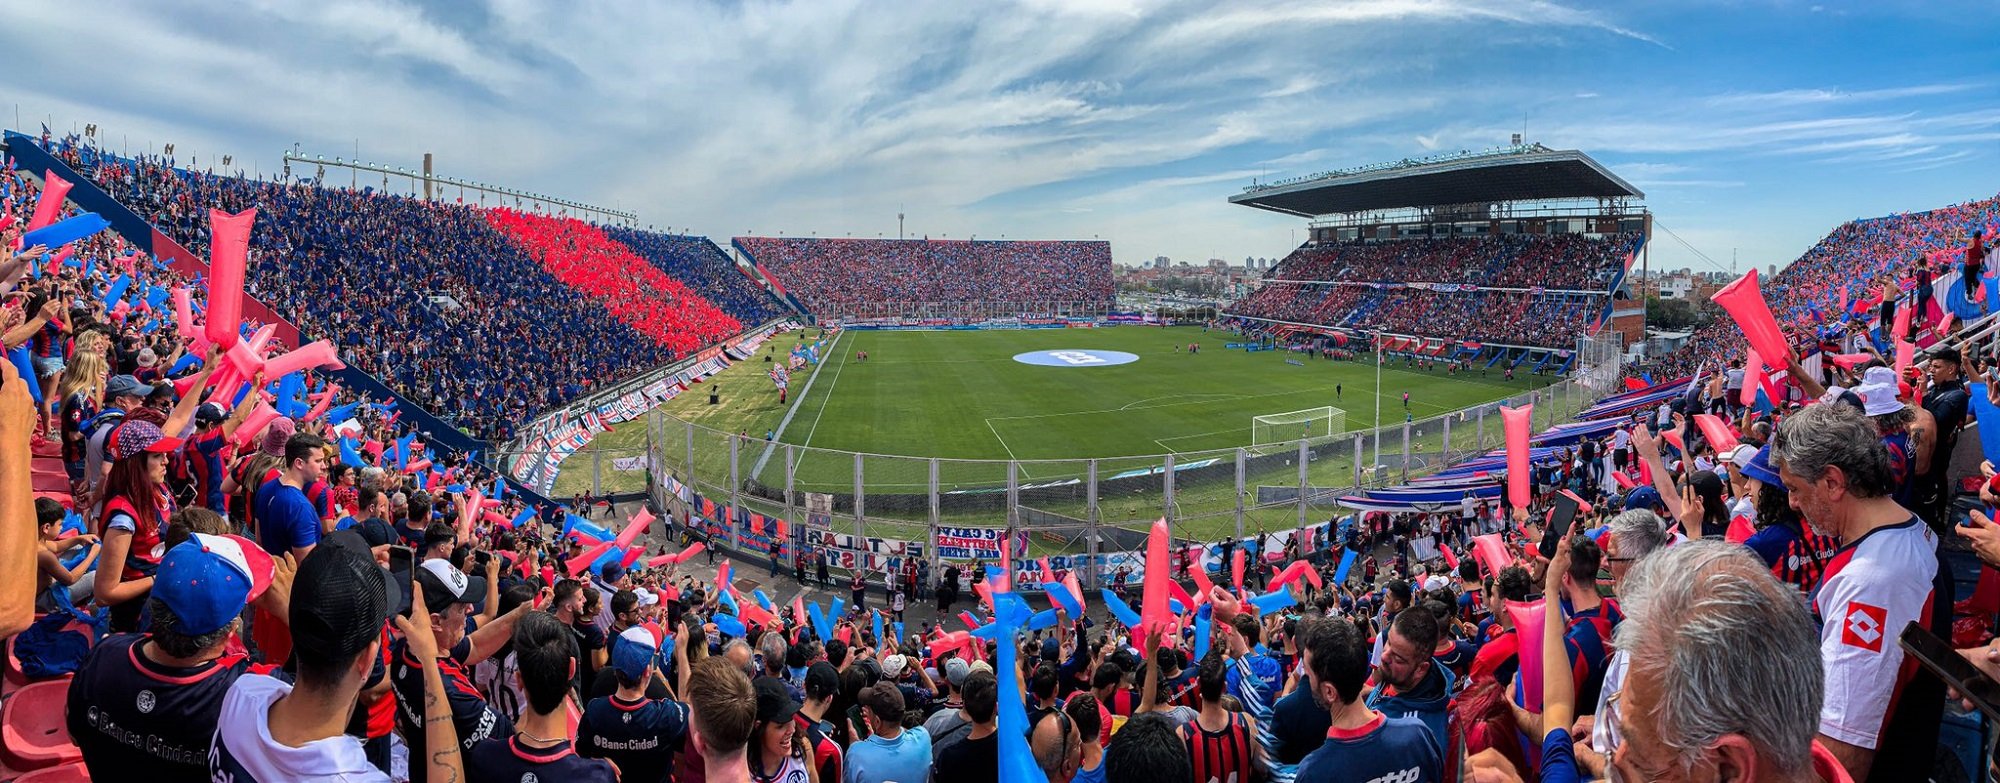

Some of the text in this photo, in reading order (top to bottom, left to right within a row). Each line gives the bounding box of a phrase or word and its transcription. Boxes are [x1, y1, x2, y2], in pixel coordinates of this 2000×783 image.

[591, 390, 619, 407] POERADE
[1815, 547, 1835, 560] Ciuda
[463, 705, 493, 750] Dexter
[98, 711, 142, 750] Banco
[146, 734, 206, 767] Ciudad
[601, 735, 659, 750] Banco Ciudad
